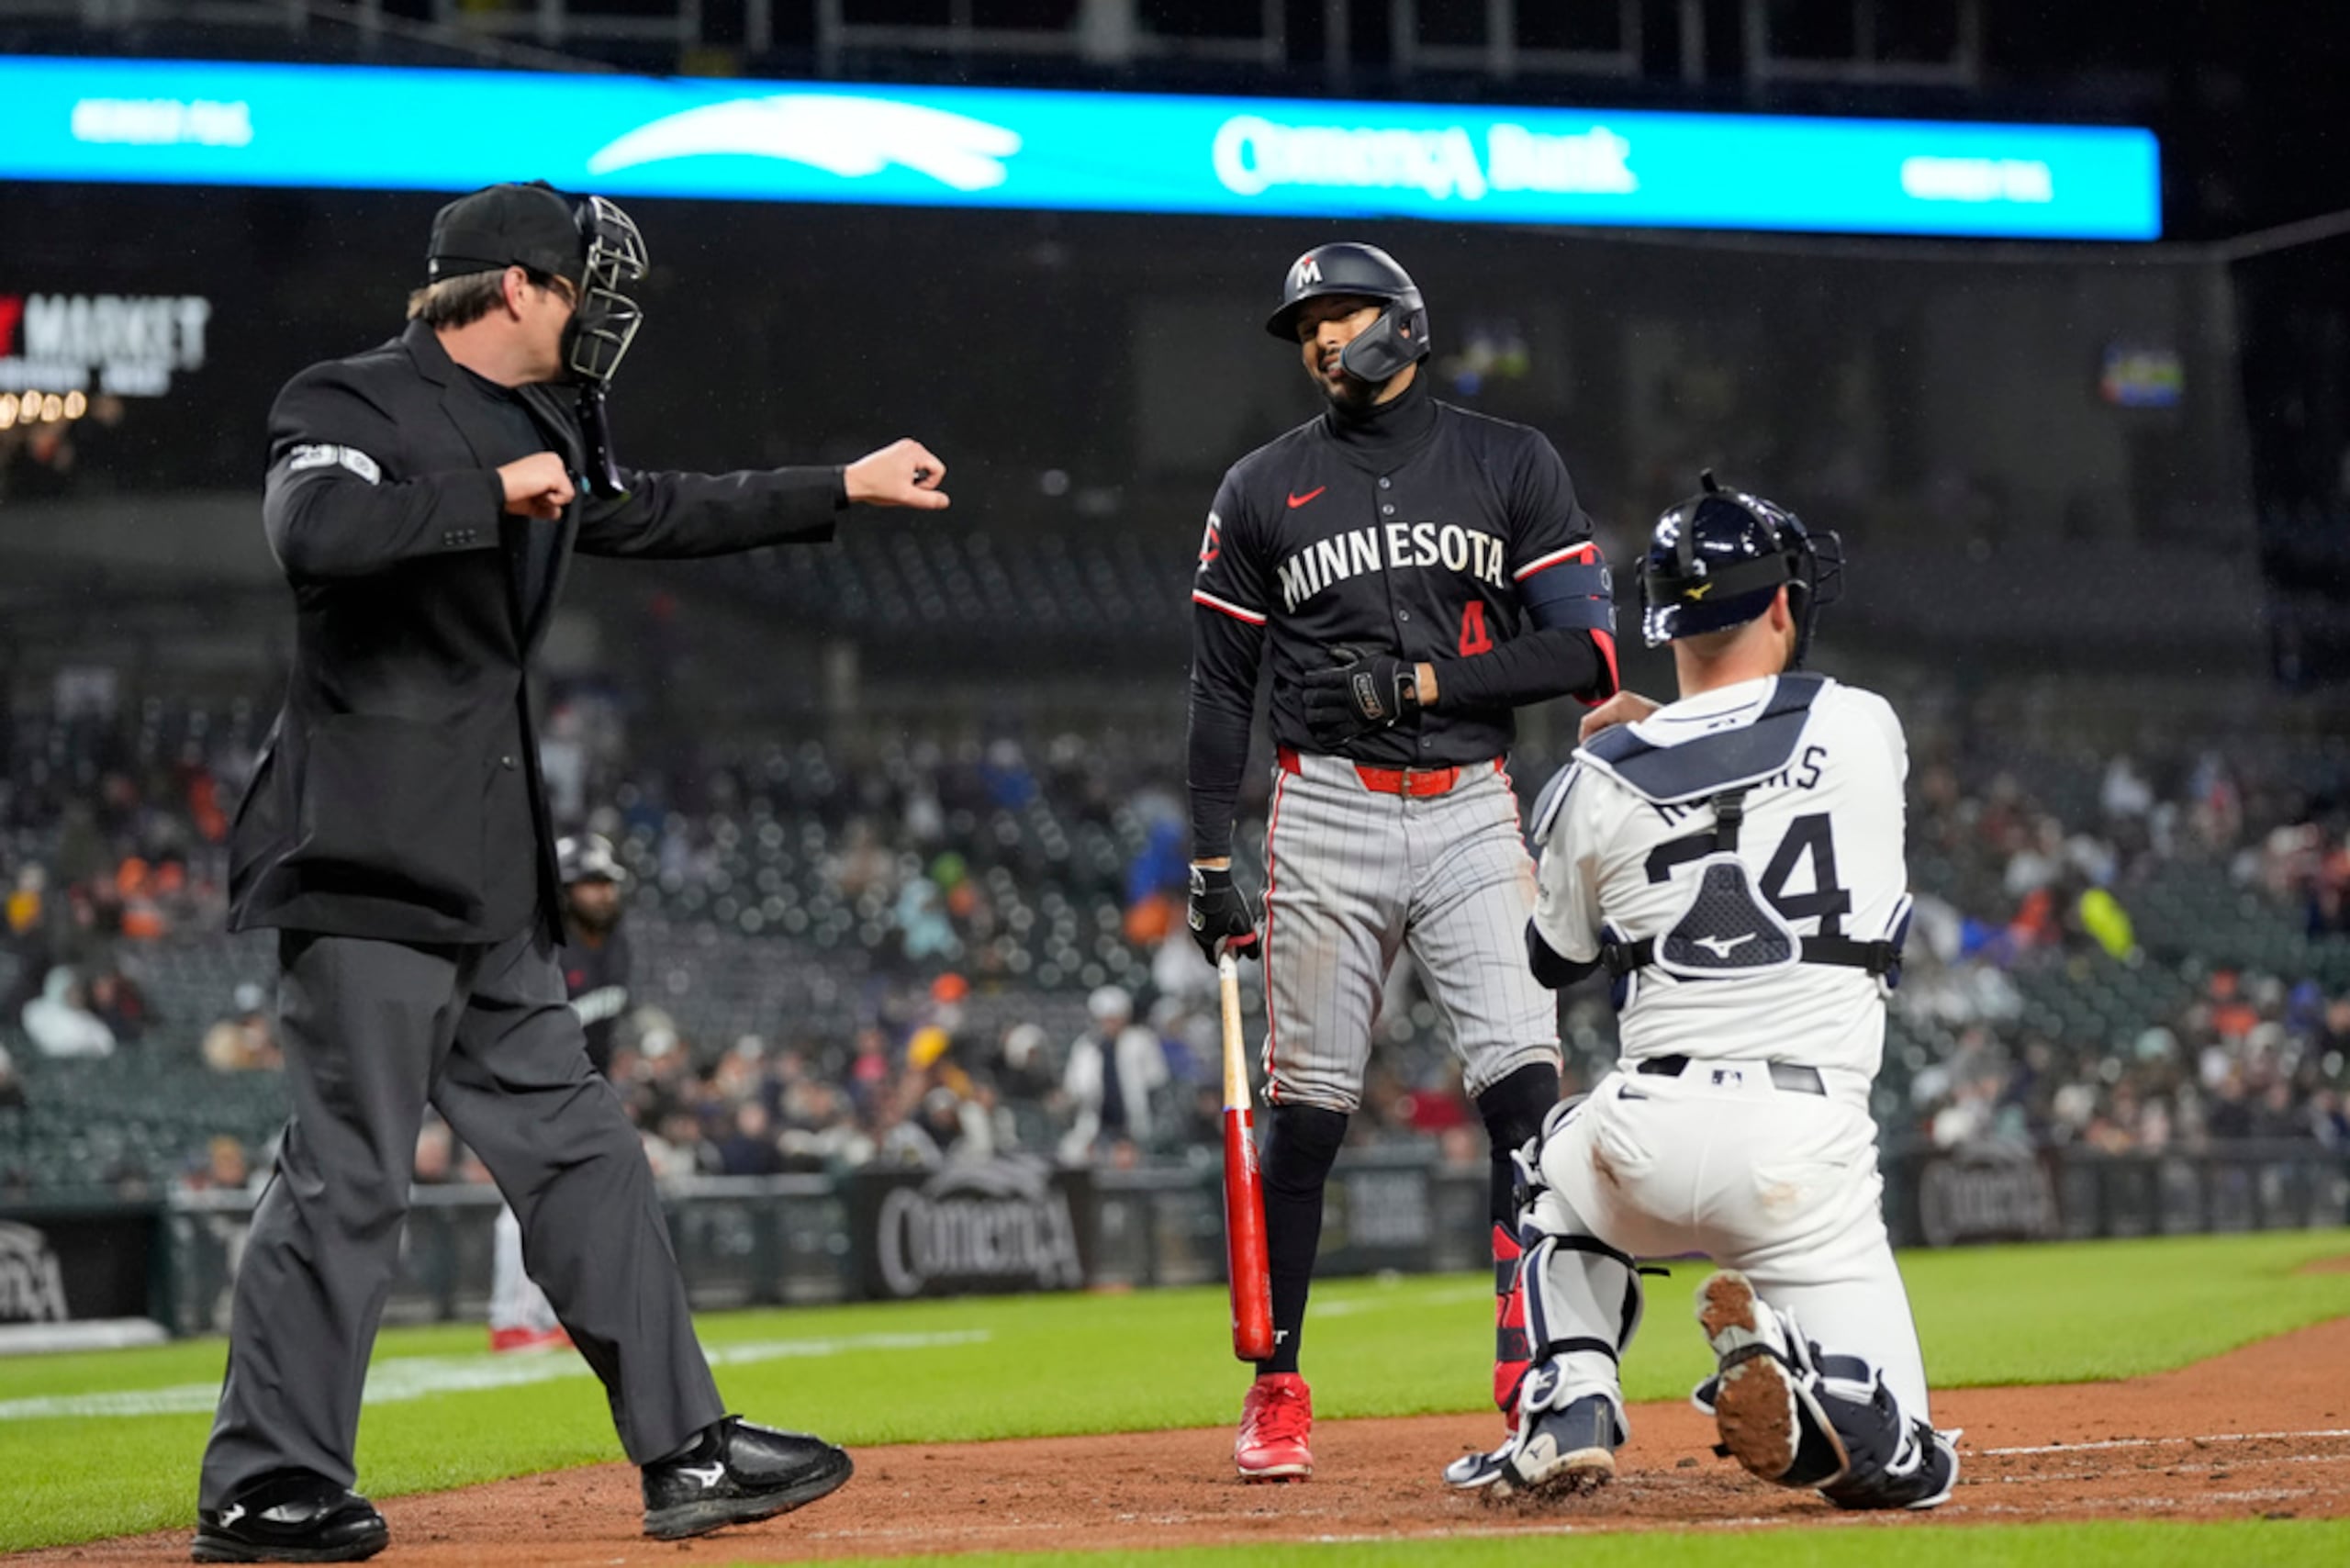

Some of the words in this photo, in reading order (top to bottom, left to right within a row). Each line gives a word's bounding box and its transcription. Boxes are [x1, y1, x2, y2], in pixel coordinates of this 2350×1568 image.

[1295, 258, 1324, 290] M
[1277, 522, 1505, 614] MINNESOTA
[1459, 600, 1493, 657] 4
